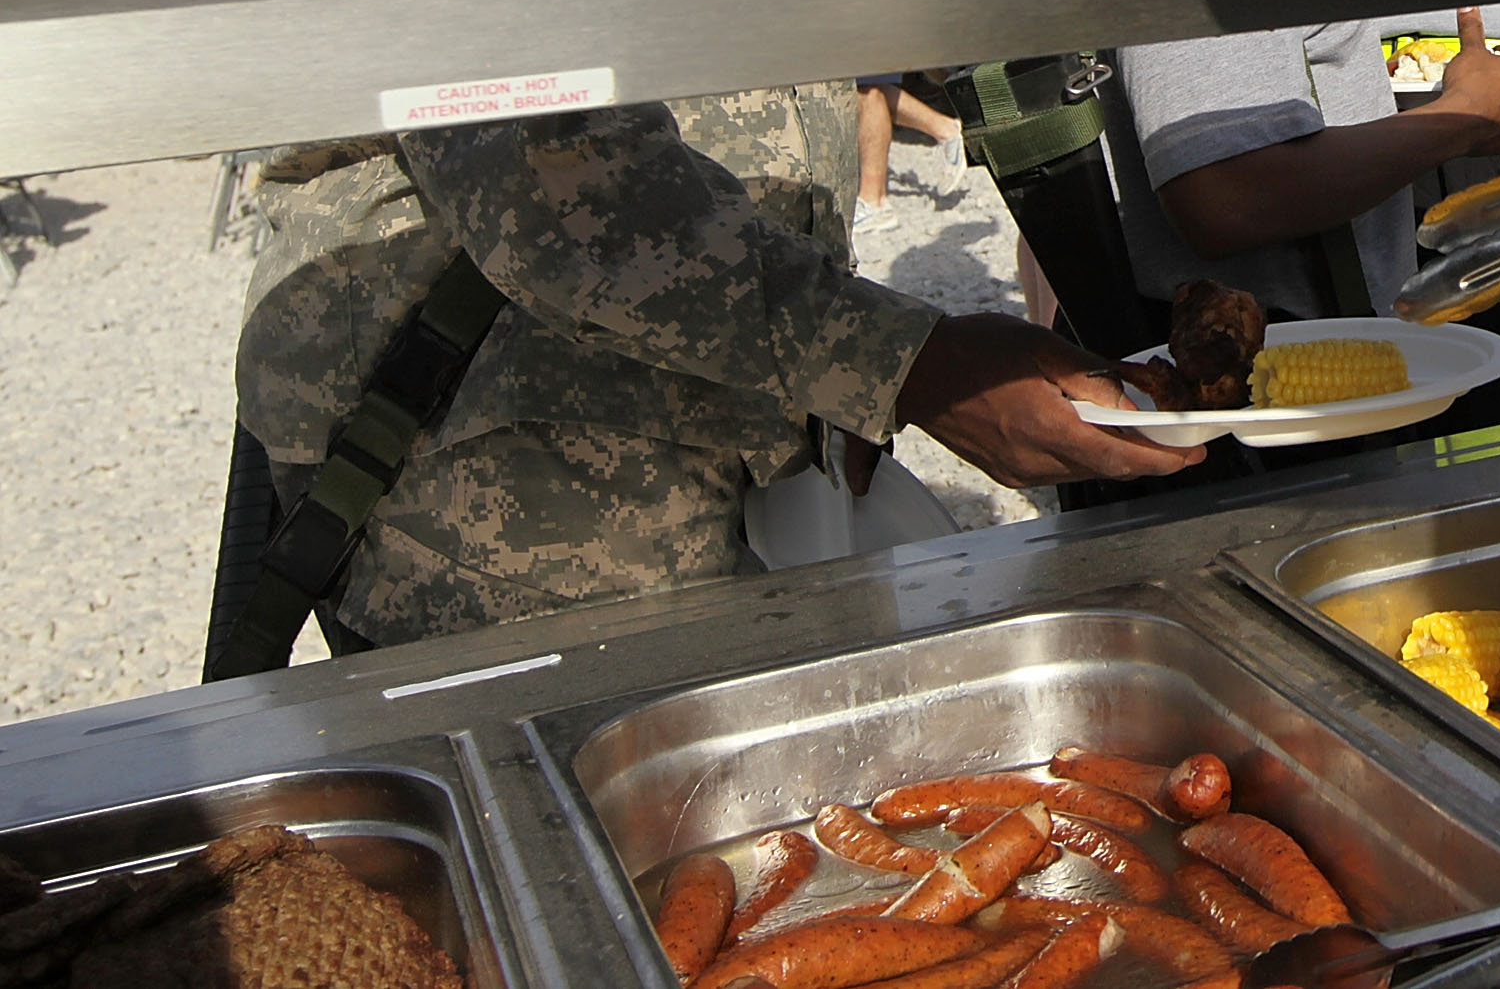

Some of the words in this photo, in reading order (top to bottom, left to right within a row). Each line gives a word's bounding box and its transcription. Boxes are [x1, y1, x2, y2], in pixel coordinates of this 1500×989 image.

[437, 81, 511, 101] CAUTION
[525, 76, 559, 91] HOT
[407, 99, 499, 121] ATTENTION
[513, 89, 590, 110] BRULANT
